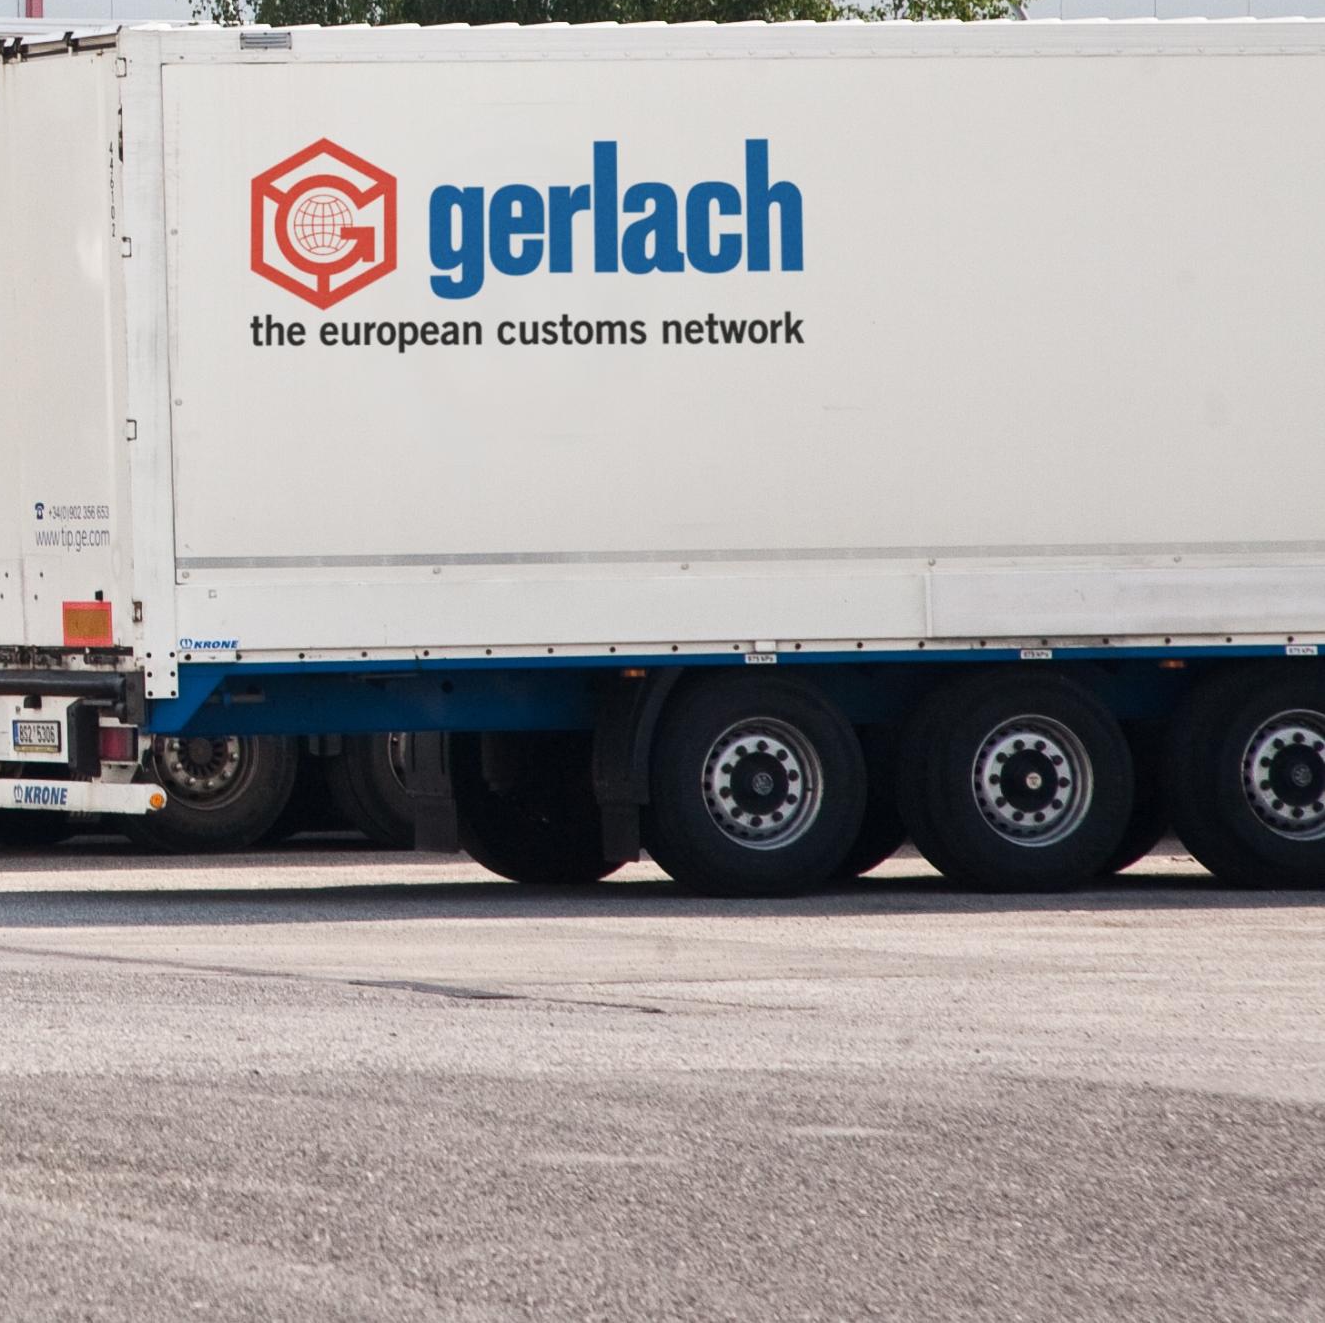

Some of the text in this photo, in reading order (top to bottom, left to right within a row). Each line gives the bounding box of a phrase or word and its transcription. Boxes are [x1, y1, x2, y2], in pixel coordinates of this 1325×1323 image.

[429, 138, 804, 300] gerlach
[250, 311, 805, 354] the european customs network
[194, 640, 238, 649] KRONE
[24, 786, 68, 805] KRONE
